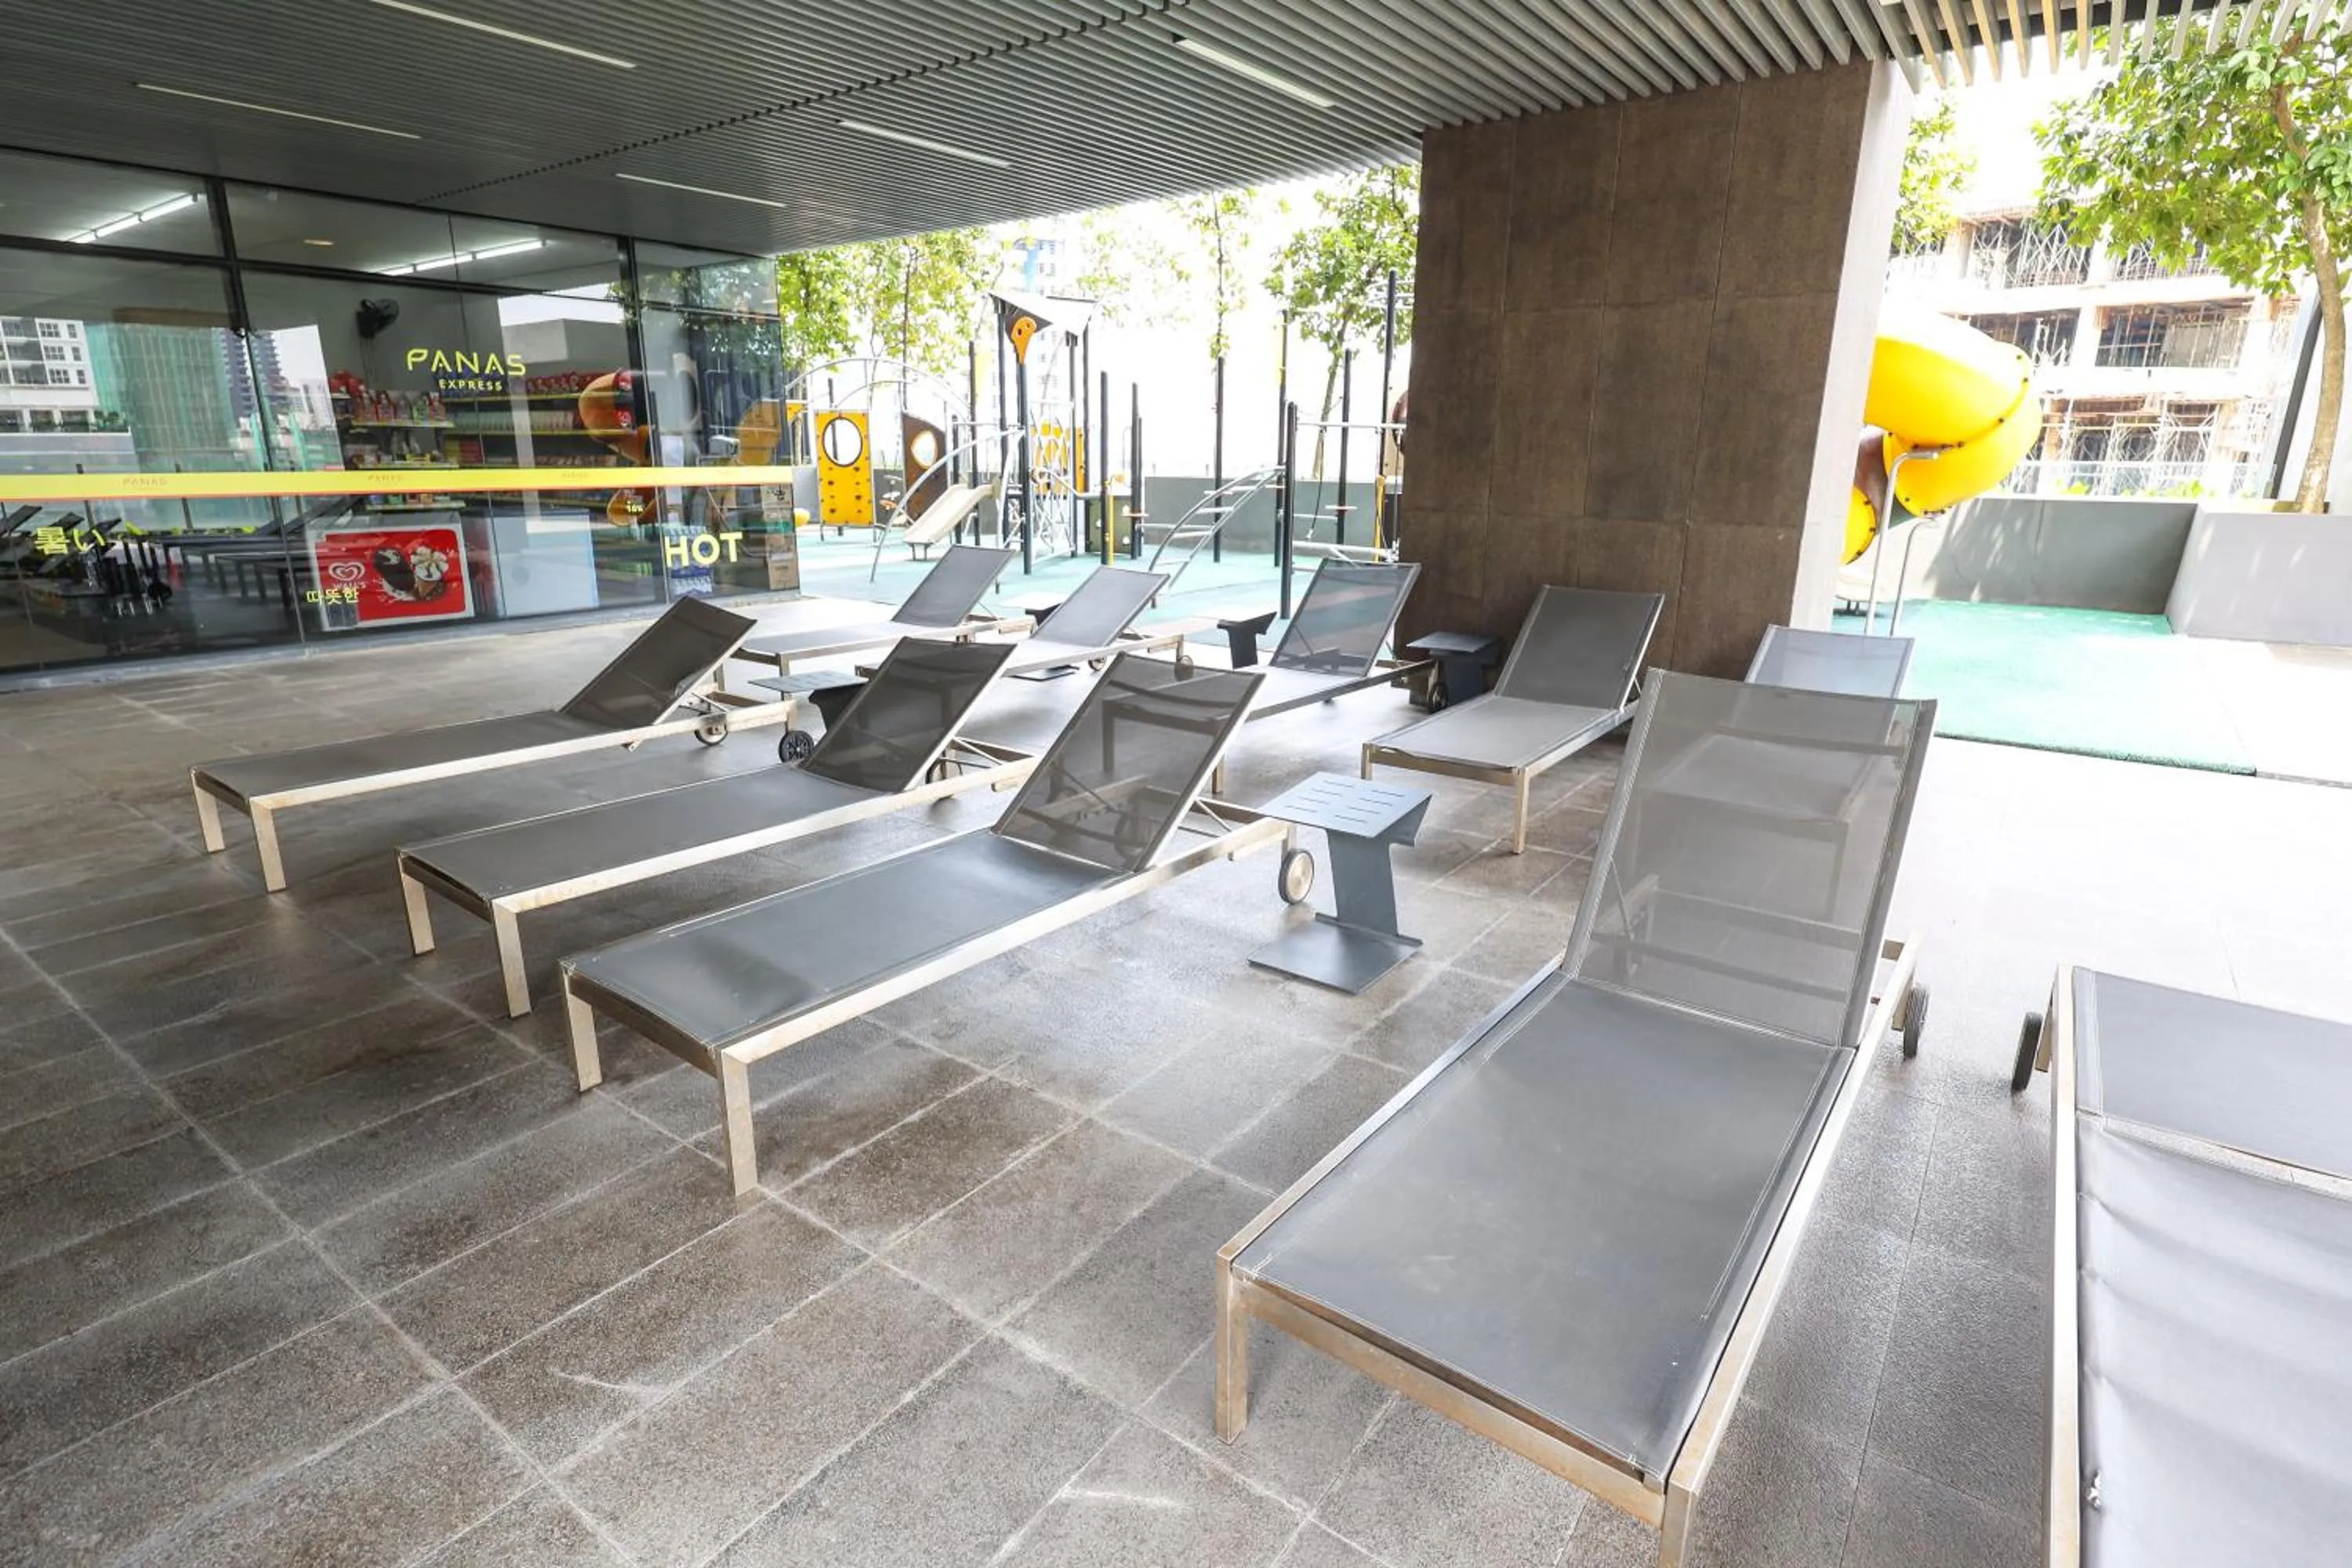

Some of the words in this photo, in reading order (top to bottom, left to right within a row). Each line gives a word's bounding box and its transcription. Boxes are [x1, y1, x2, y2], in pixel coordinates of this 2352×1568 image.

[407, 348, 526, 376] PANAS
[438, 379, 503, 391] EXPRESS
[34, 526, 106, 555] 暑い
[664, 531, 742, 568] HOT
[306, 588, 360, 605] 따뜻한
